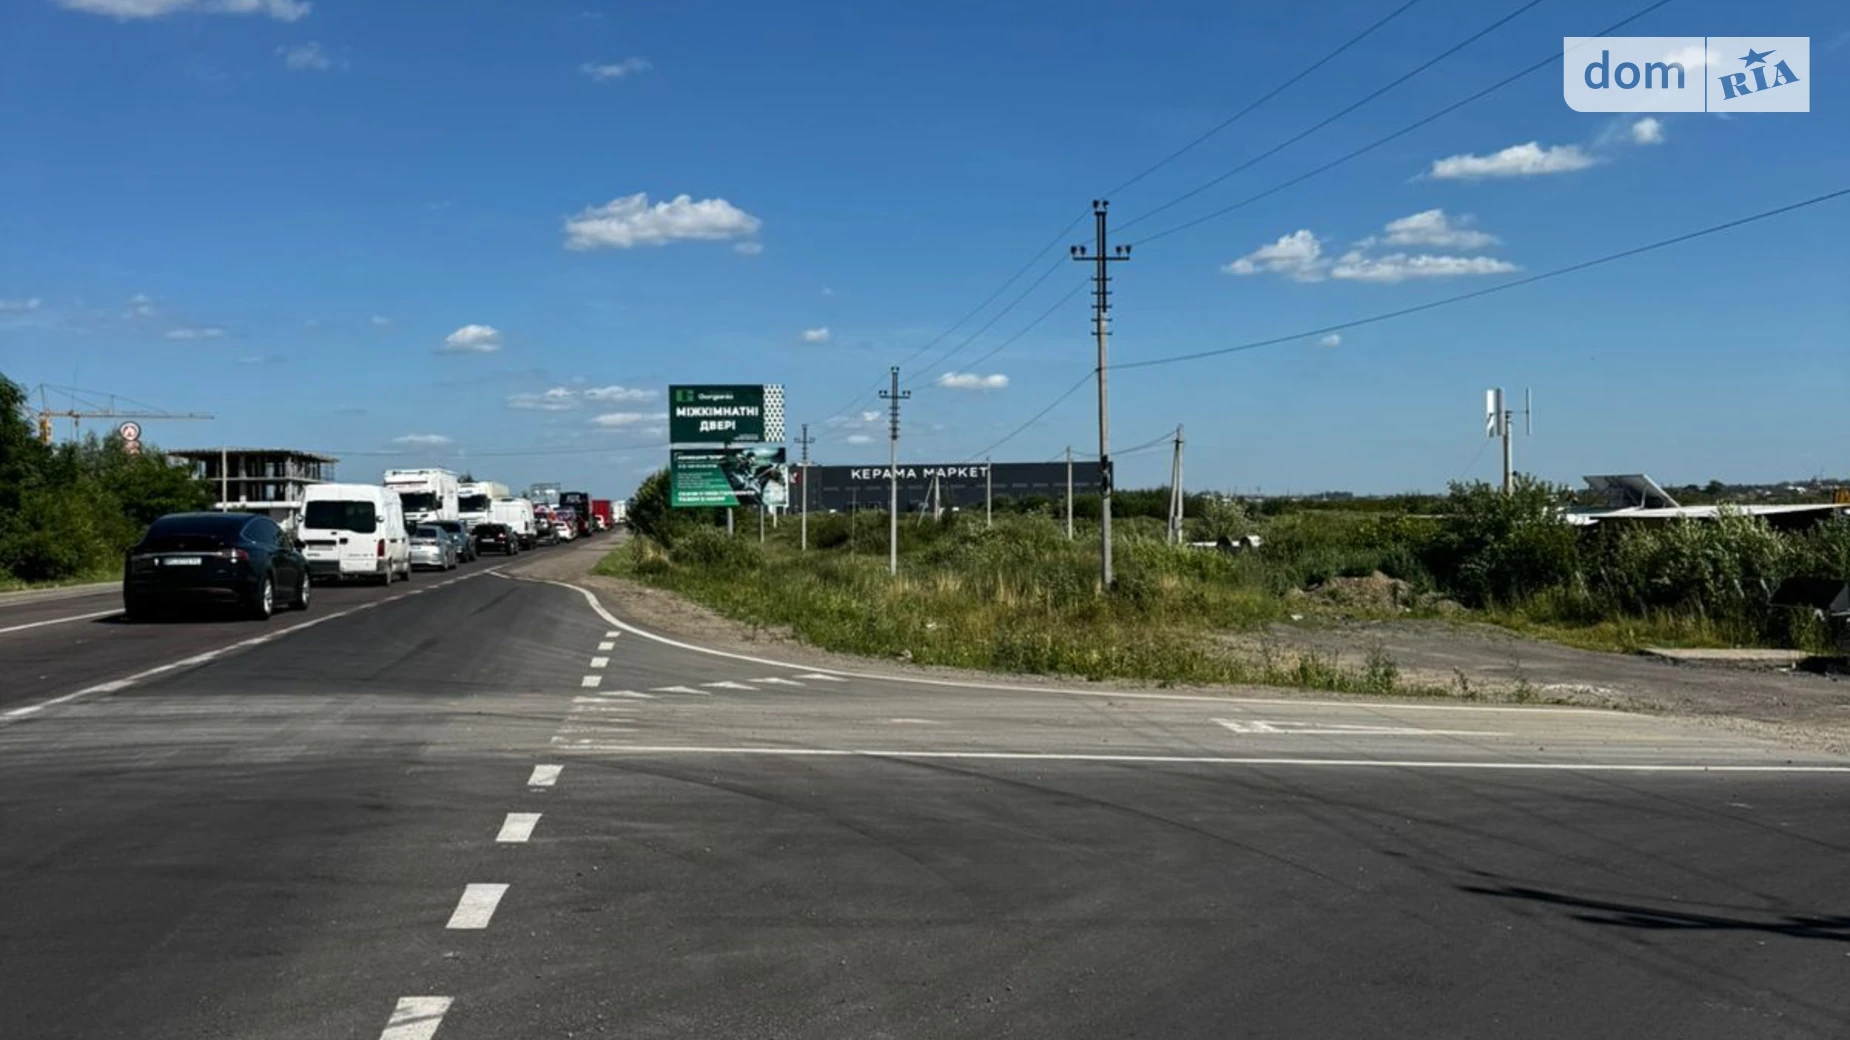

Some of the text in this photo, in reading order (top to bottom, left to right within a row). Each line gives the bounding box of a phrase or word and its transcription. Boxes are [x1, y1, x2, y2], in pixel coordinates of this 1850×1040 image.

[676, 406, 759, 417] МІЖКІМНАТНІ
[699, 420, 736, 432] ДВЕРІ
[851, 467, 988, 480] КЕРАМА МАРКЕТ
